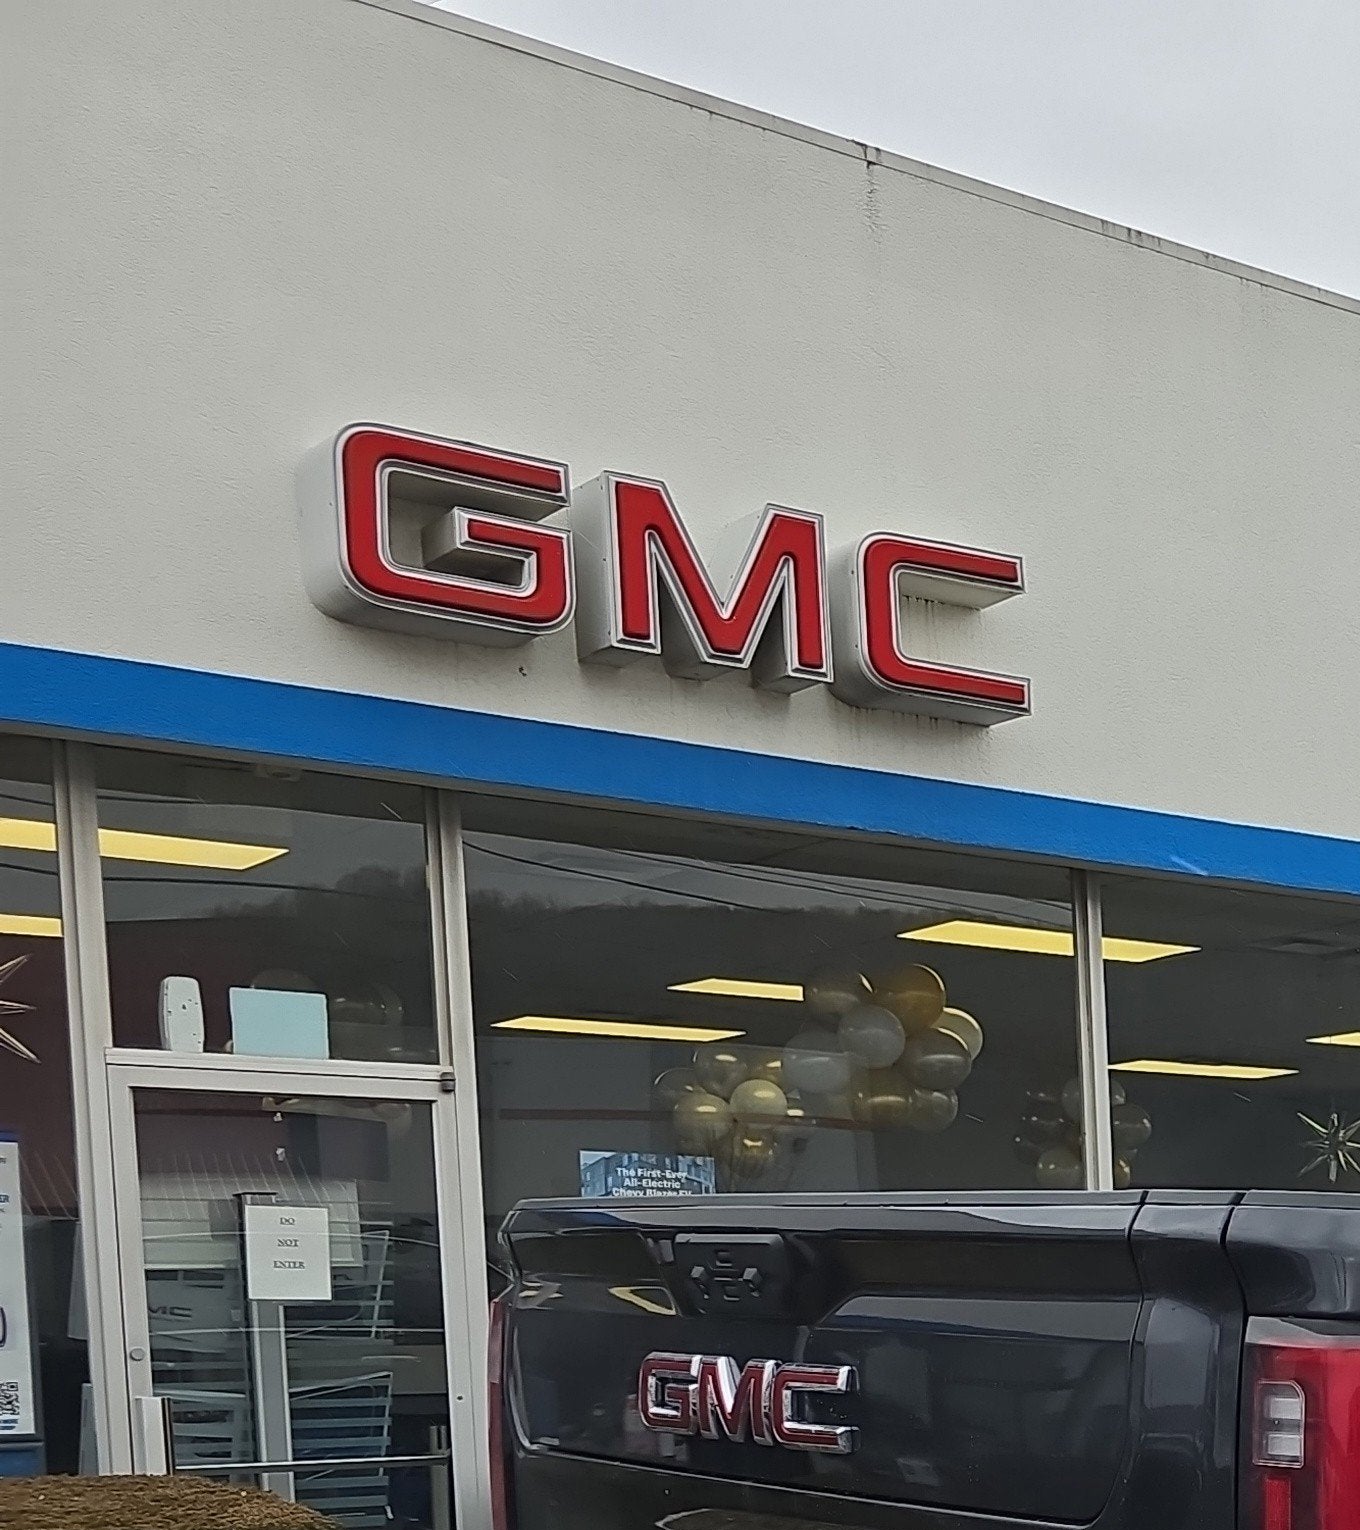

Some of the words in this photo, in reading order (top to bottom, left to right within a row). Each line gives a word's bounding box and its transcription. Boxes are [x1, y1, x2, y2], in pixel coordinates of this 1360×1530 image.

[333, 421, 1032, 725] GMC
[616, 1167, 636, 1177] The
[637, 1168, 688, 1179] First-Ever
[623, 1178, 681, 1189] All-Electric
[612, 1187, 645, 1197] Chevy
[280, 1217, 296, 1226] DO
[277, 1239, 300, 1247] NOT
[273, 1260, 306, 1269] ENTER
[638, 1351, 862, 1454] GMC
